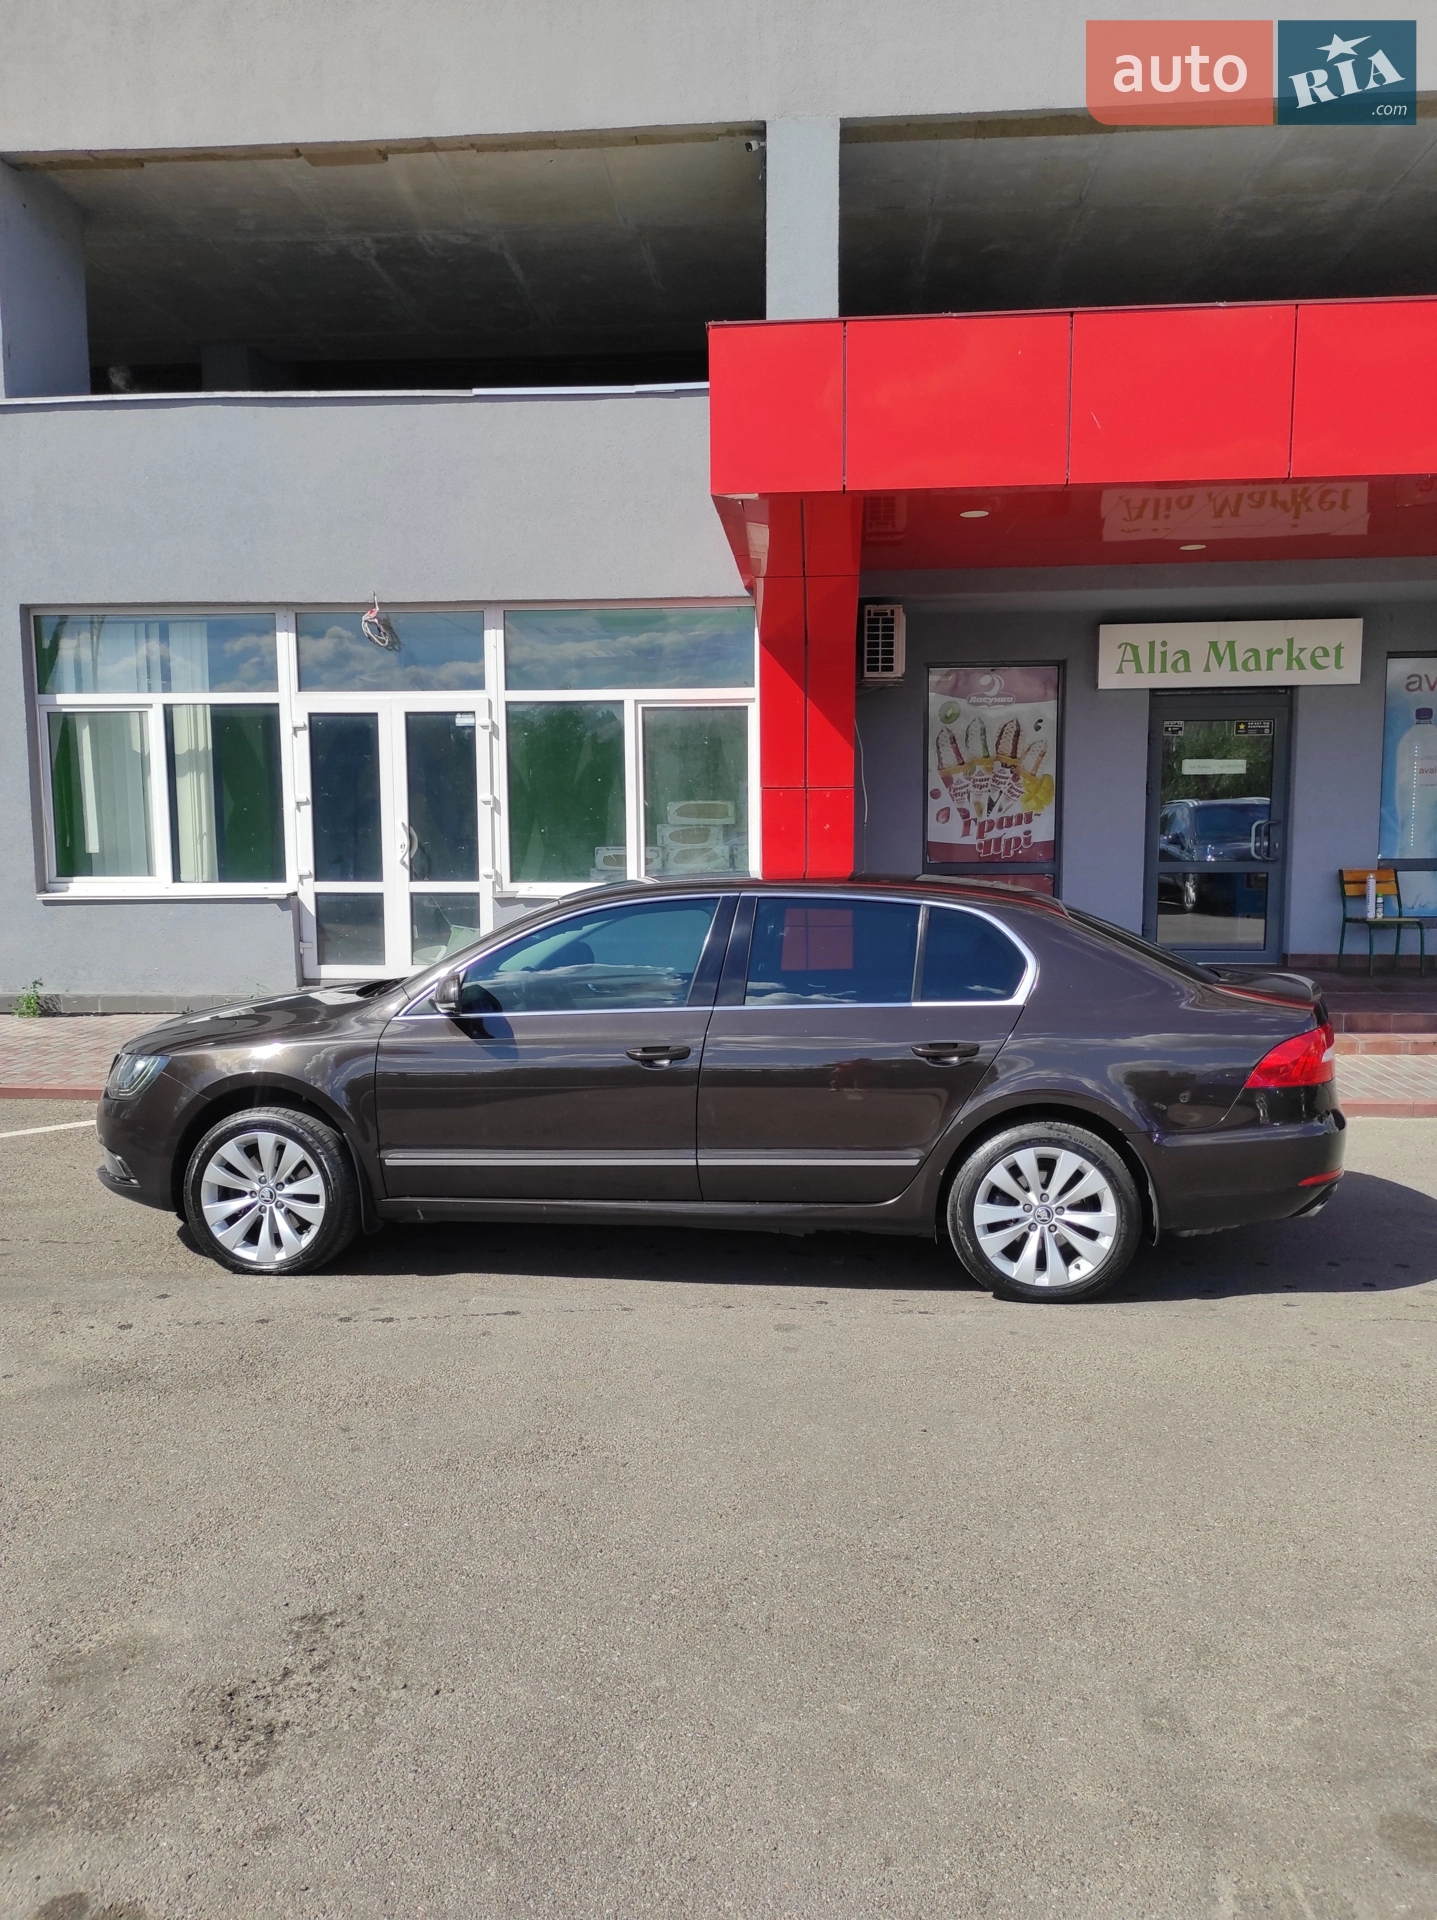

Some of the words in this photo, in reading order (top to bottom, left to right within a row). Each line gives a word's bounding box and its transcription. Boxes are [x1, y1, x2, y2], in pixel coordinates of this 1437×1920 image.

[1115, 640, 1192, 675] Alia
[1203, 636, 1345, 673] Market
[968, 696, 1014, 704] Ласунка
[975, 829, 1035, 859] Прі
